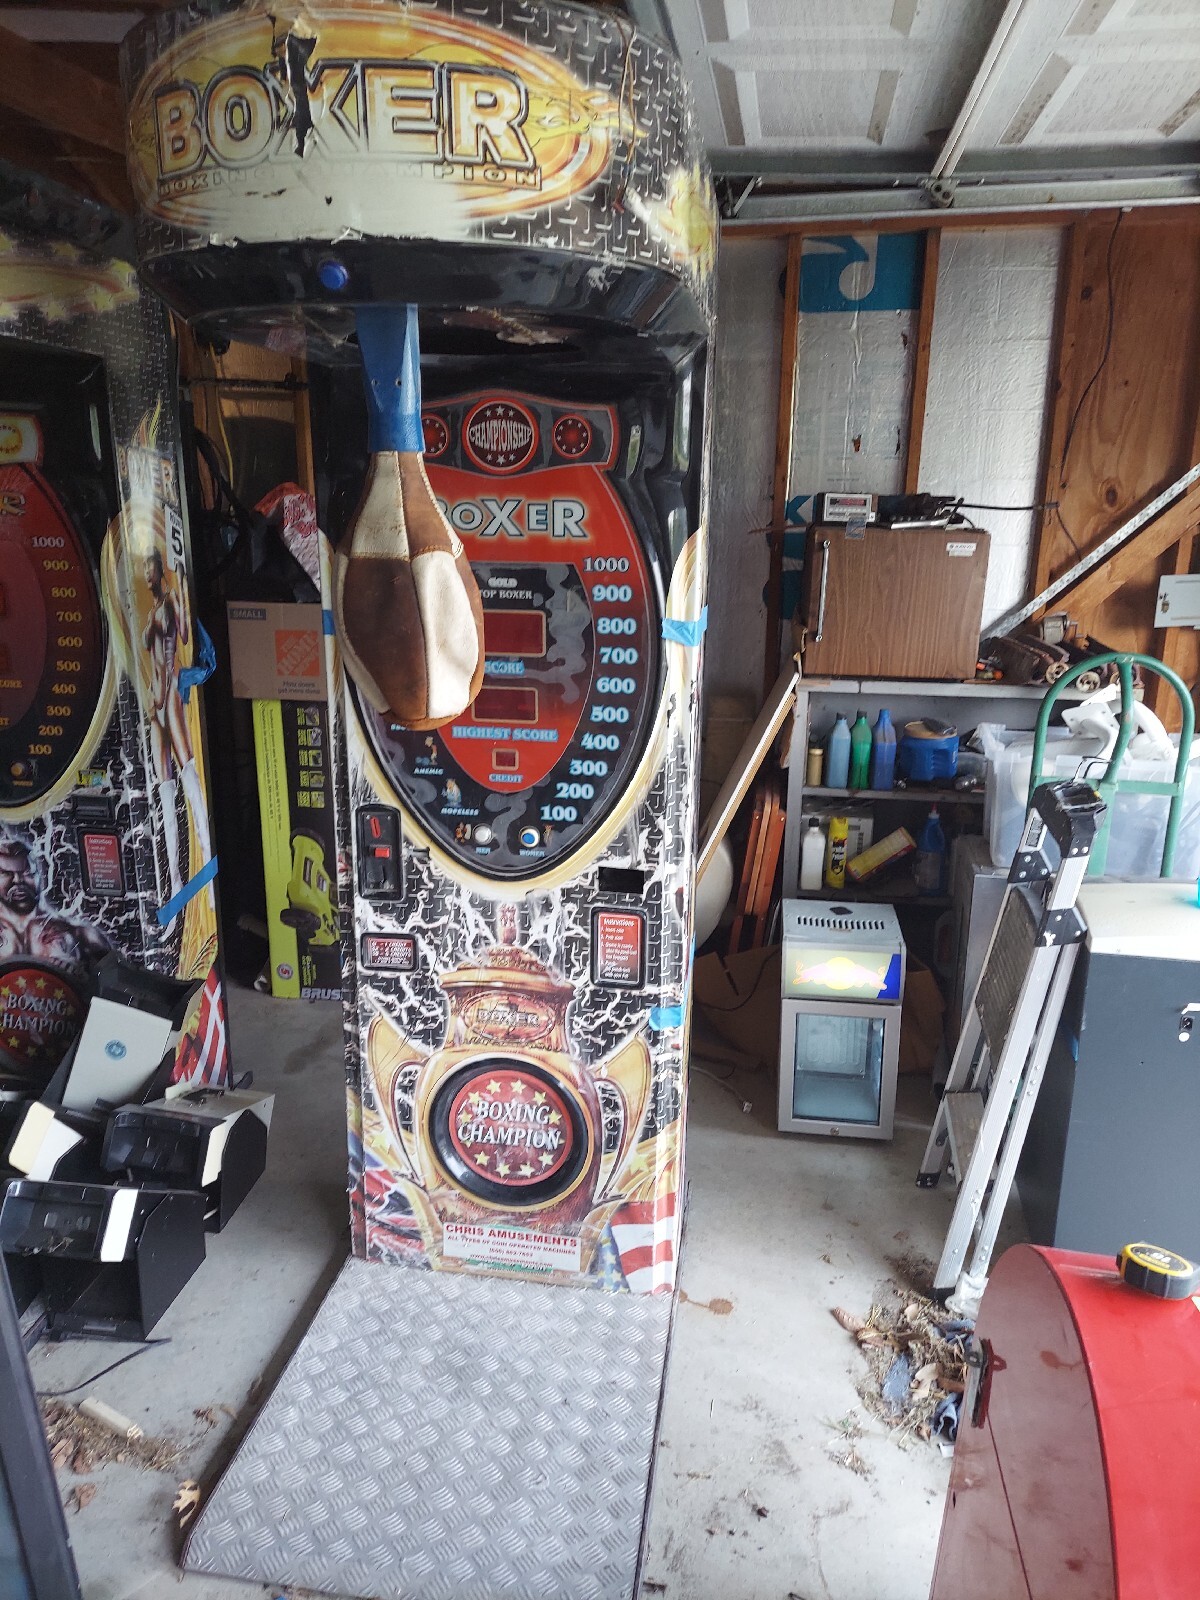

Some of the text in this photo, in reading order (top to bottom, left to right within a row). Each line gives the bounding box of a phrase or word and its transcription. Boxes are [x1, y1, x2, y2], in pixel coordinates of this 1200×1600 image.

[154, 58, 542, 181] BOXER
[468, 418, 533, 452] CHAMPIONSHIP
[32, 536, 65, 548] 1000
[171, 524, 185, 557] 5
[43, 559, 69, 571] 900
[583, 556, 630, 574] 1000
[51, 587, 77, 598] 800
[500, 590, 533, 600] BOXER
[592, 584, 632, 602] 900
[56, 611, 82, 623] 700
[233, 608, 263, 619] SMALL
[597, 617, 637, 636] 800
[57, 636, 83, 648] 600
[599, 646, 638, 665] 700
[56, 660, 81, 672] 500
[484, 660, 525, 674] SCORE
[51, 683, 77, 695] 400
[596, 676, 636, 695] 600
[46, 705, 72, 717] 300
[590, 706, 630, 724] 500
[38, 725, 63, 736] 200
[452, 725, 559, 742] HIGHEST SCORE
[28, 744, 52, 755] 100
[580, 732, 620, 750] 400
[414, 767, 444, 776] ANEMIC
[569, 759, 608, 777] 300
[489, 773, 523, 783] CREDIT
[556, 783, 594, 801] 200
[441, 807, 480, 816] HOPELESS
[540, 804, 578, 822] 100
[519, 849, 545, 857] WOMEN
[7, 993, 67, 1016] BOXING
[0, 1012, 76, 1037] HAMPION
[476, 1099, 550, 1125] BOXING
[457, 1122, 562, 1151] CHAMPION
[445, 1224, 578, 1247] CHRIS AMUSEMENTS
